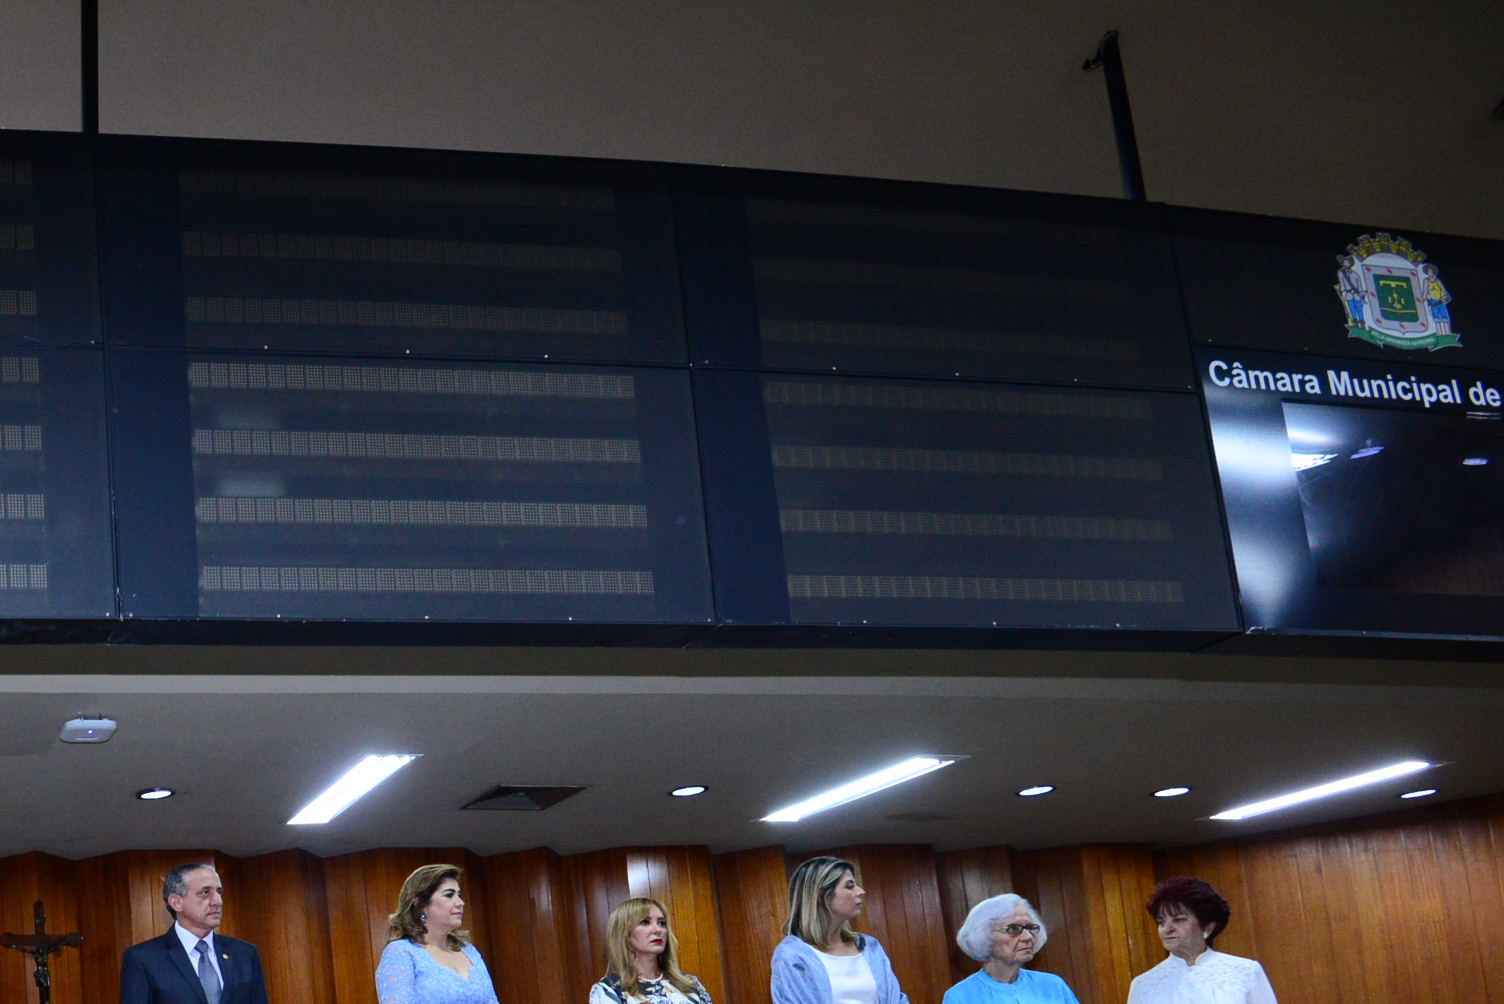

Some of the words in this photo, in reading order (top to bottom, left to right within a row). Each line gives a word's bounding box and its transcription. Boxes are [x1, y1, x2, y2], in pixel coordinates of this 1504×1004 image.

[1208, 360, 1321, 394] Câmara
[1326, 370, 1462, 408] Municipal
[1468, 381, 1501, 407] de
